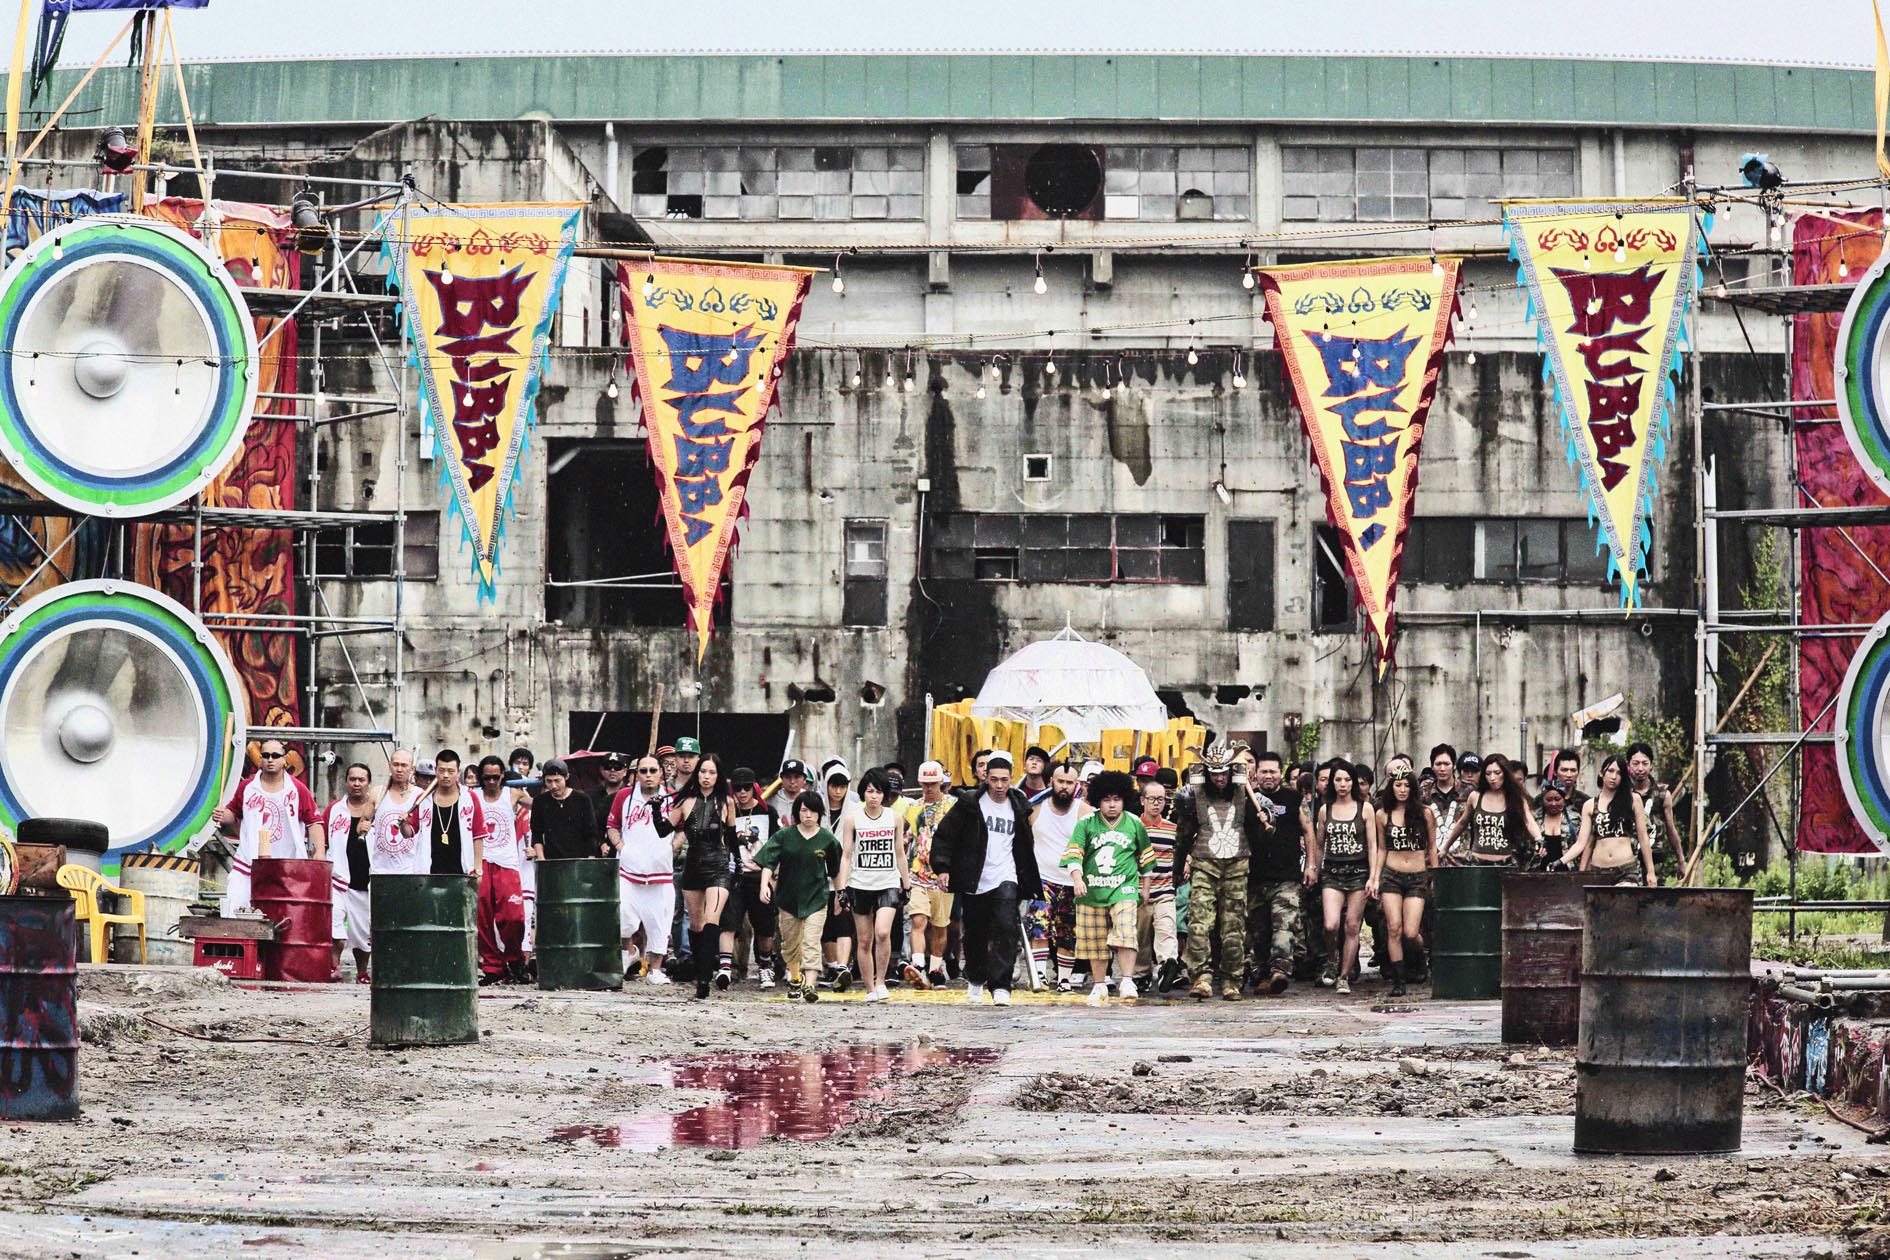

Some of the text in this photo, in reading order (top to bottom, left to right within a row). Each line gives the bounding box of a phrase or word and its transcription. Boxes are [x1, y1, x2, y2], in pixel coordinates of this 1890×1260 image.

[422, 262, 537, 493] BUBBA
[1548, 259, 1668, 492] BUBBA
[658, 322, 769, 549] BUBBA
[1476, 814, 1505, 829] GIRA
[858, 829, 894, 838] VISION
[1327, 822, 1357, 836] GIRA
[1479, 826, 1504, 838] GIRA
[859, 838, 893, 851] STREET
[1329, 834, 1358, 845] GIRA
[1478, 836, 1509, 850] GIRLS
[1330, 843, 1363, 855] GIRLS
[860, 853, 892, 867] WEAR
[1095, 845, 1117, 874] 4
